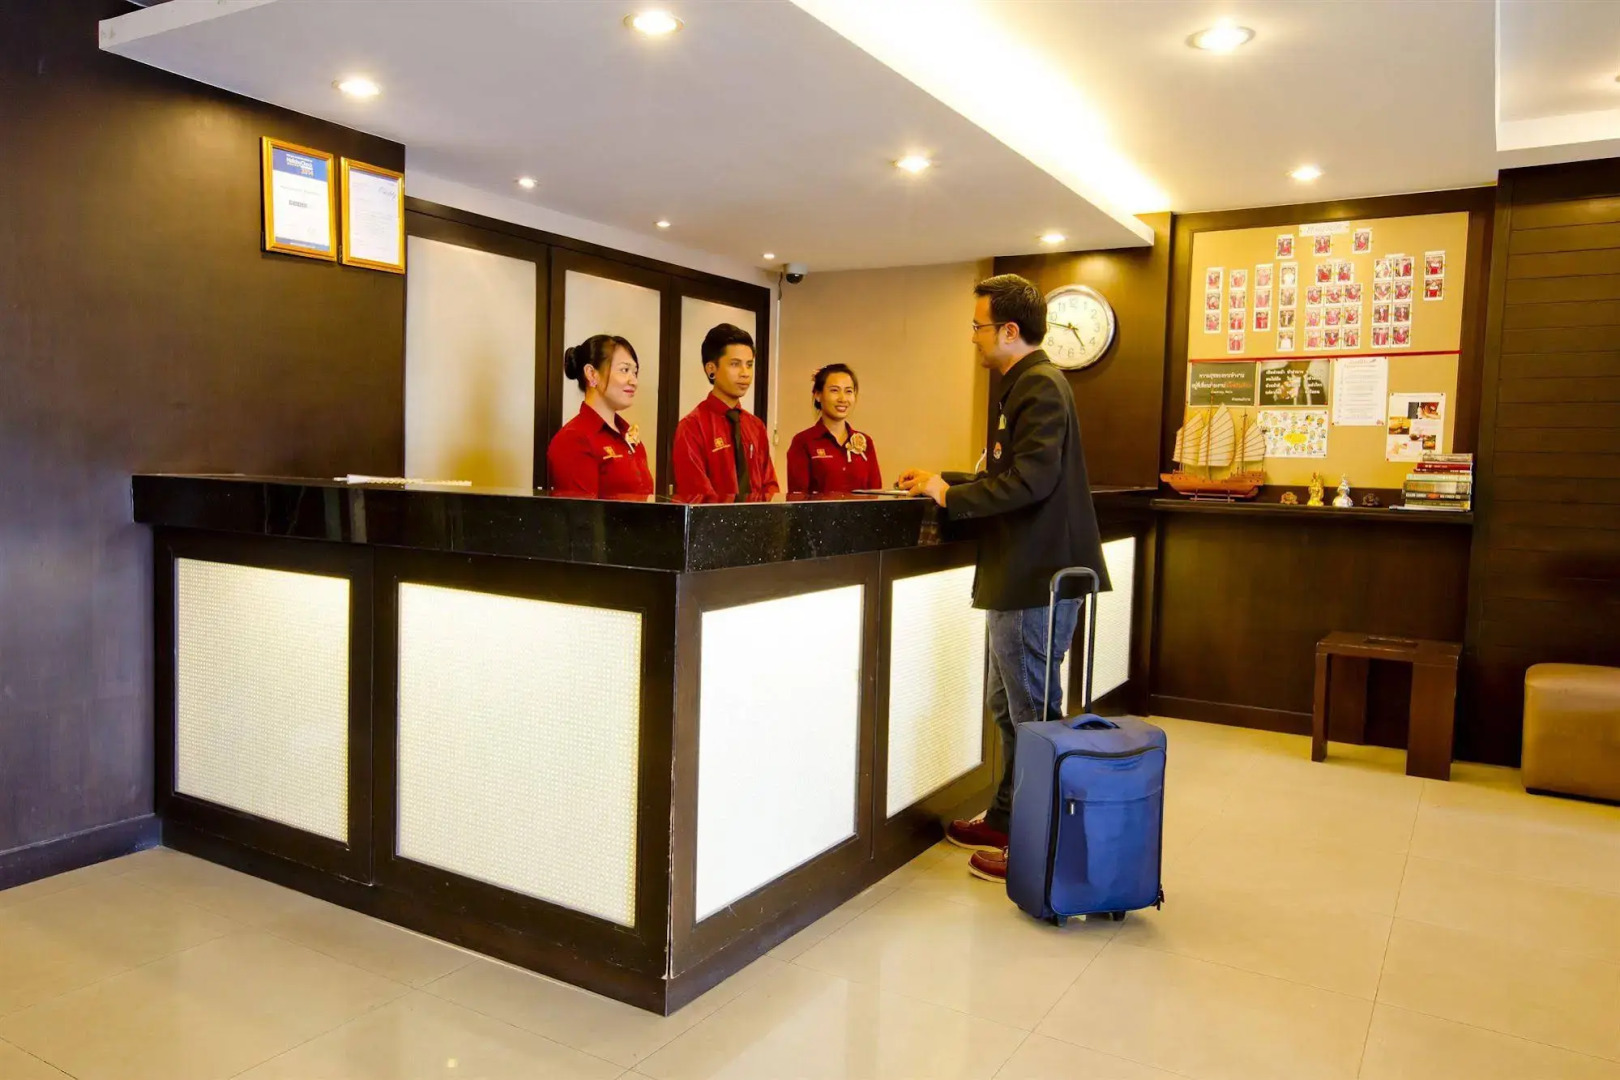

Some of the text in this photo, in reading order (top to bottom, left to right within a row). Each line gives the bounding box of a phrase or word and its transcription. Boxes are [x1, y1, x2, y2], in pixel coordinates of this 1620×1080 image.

[1058, 302, 1066, 312] 11
[1069, 297, 1078, 309] 12
[1091, 308, 1097, 319] 2
[1094, 322, 1100, 333] 3
[1047, 336, 1054, 347] 8
[1090, 336, 1096, 345] 4
[1058, 345, 1064, 355] 7
[1068, 347, 1075, 357] 6
